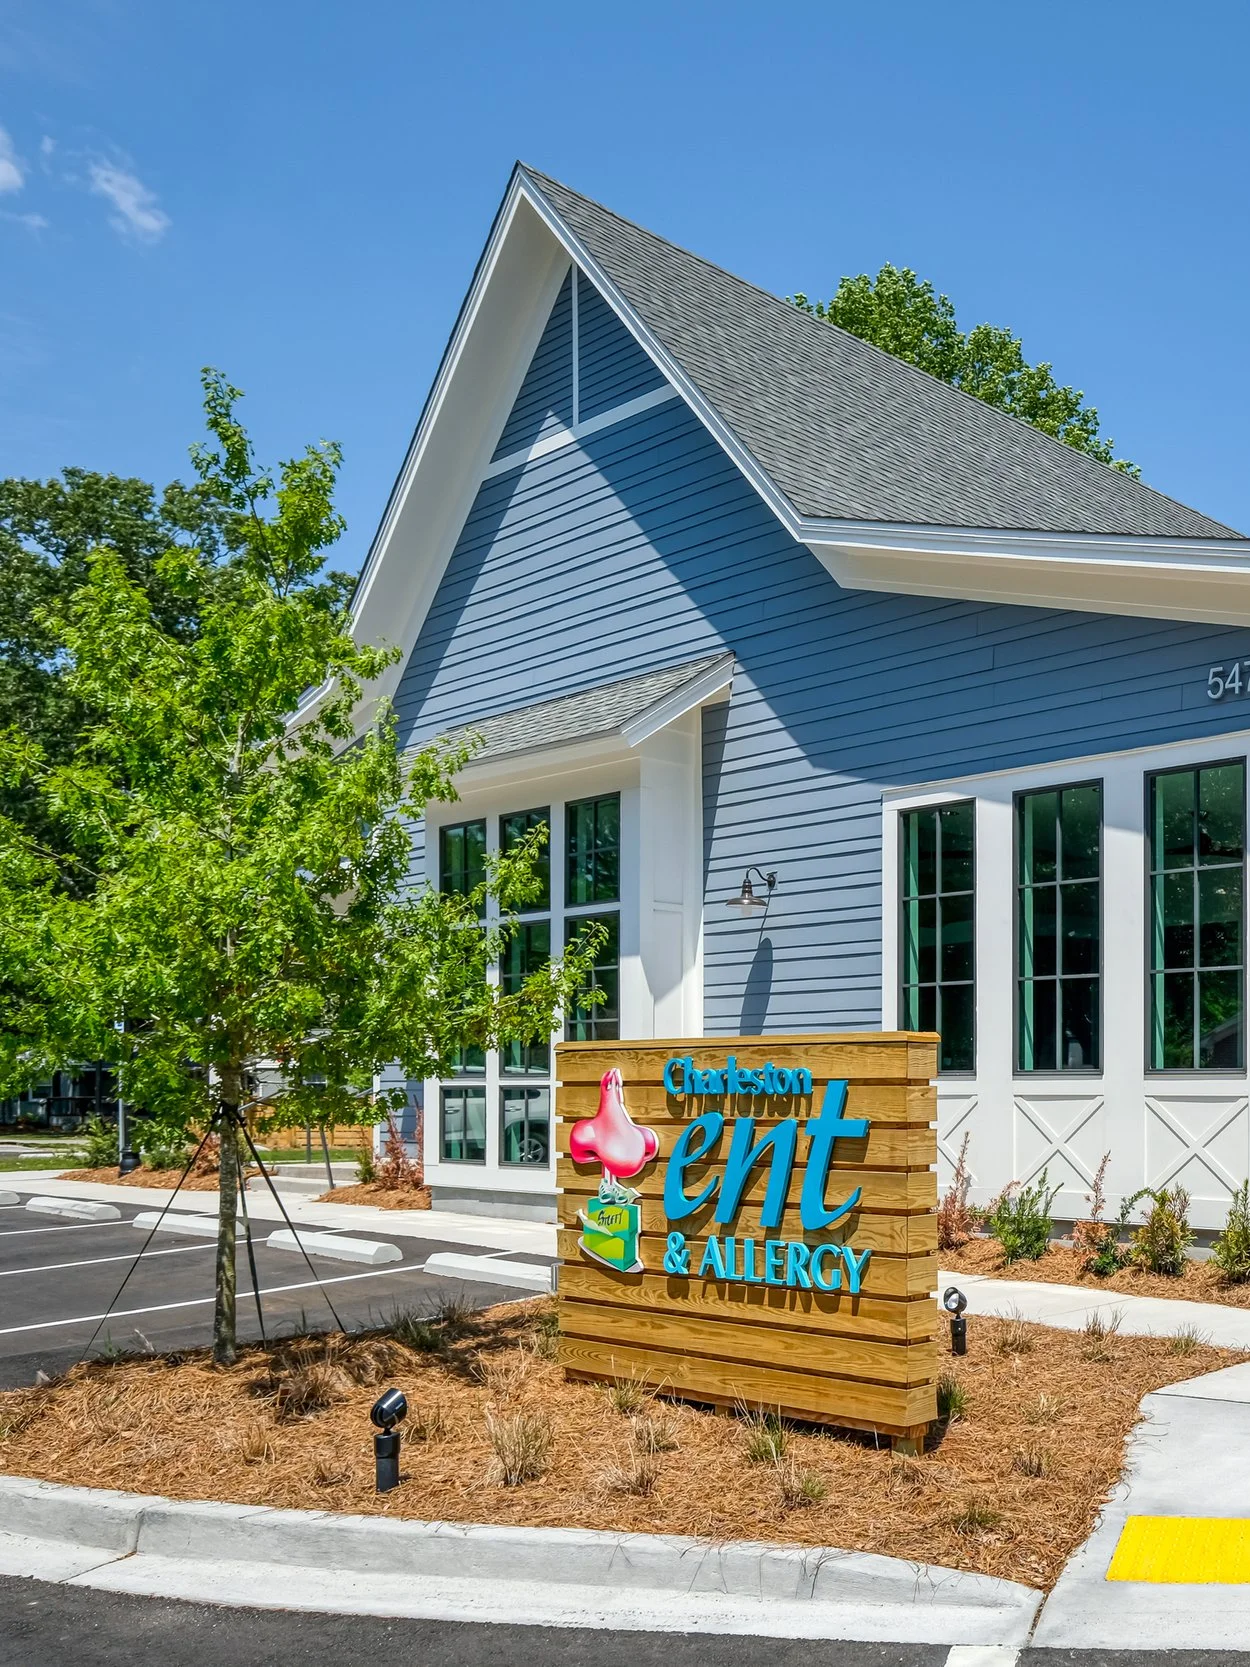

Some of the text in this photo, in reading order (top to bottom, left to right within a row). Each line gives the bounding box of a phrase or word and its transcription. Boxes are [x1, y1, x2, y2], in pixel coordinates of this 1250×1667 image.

[663, 1055, 814, 1095] Charleston
[663, 1079, 871, 1231] ent
[663, 1231, 872, 1293] & ALLERGY
